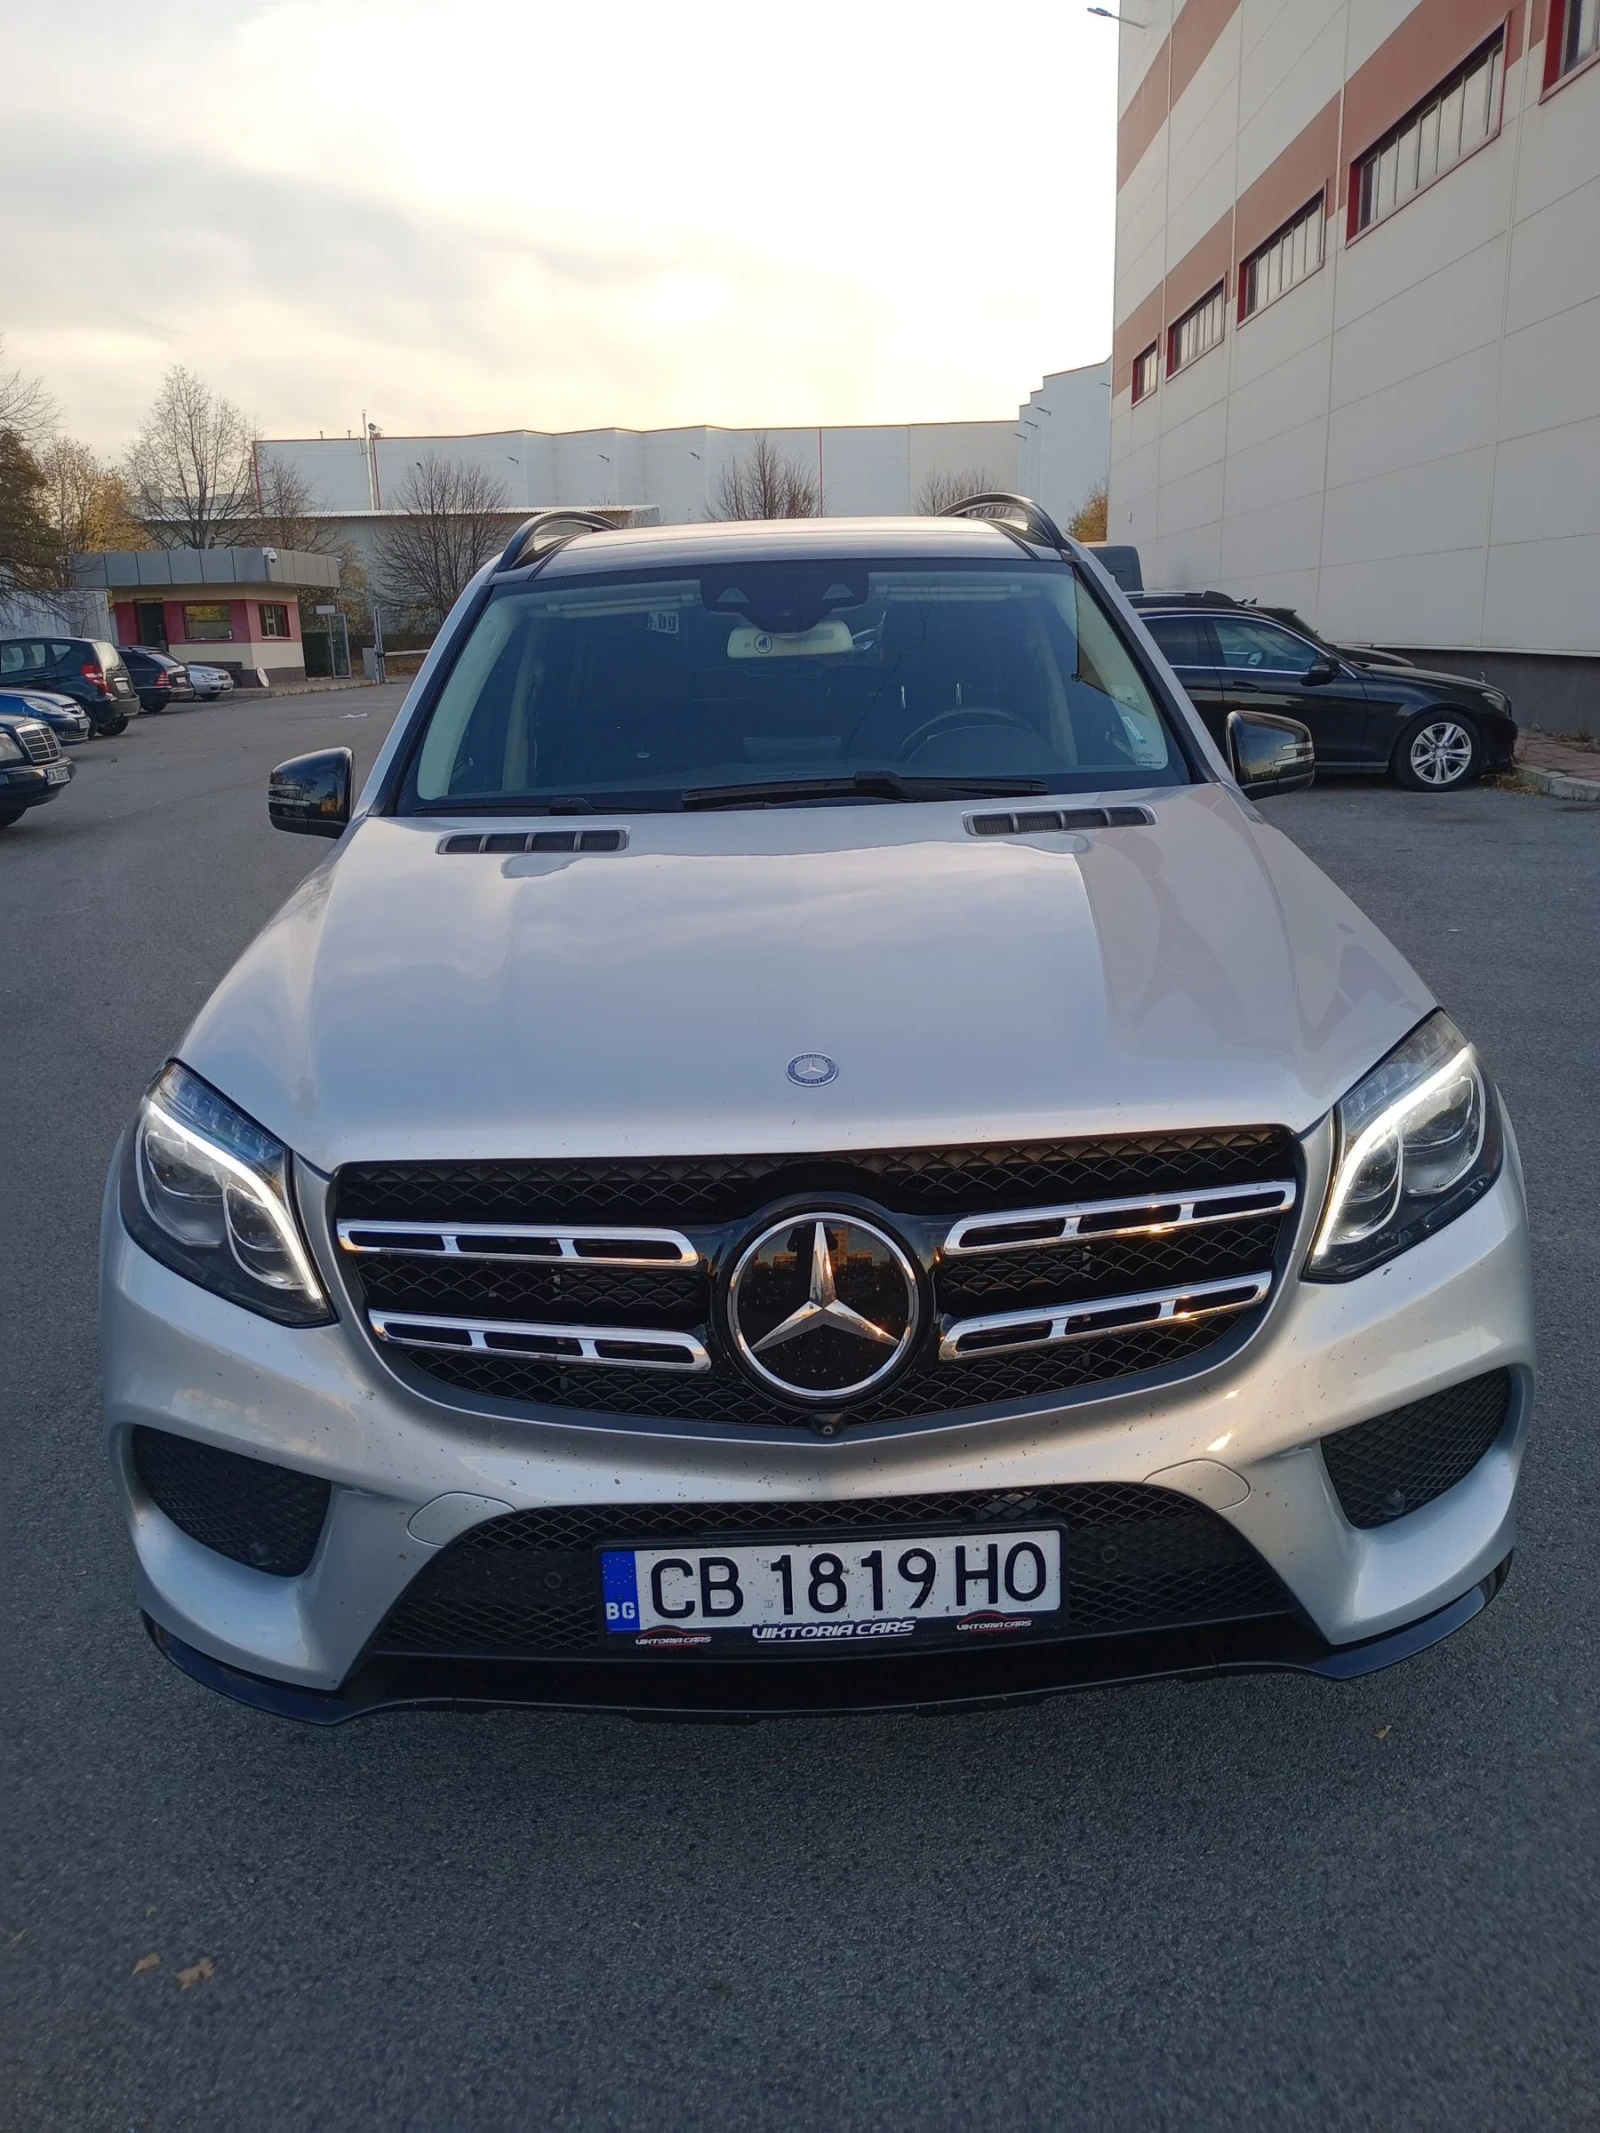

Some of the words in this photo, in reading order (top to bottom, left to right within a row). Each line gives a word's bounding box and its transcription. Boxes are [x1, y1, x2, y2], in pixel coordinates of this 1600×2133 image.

[651, 1557, 744, 1619] CB
[770, 1548, 937, 1616] 1819
[955, 1541, 1047, 1607] HO
[606, 1601, 635, 1620] BG
[752, 1624, 853, 1639] VIKTORIA
[856, 1620, 917, 1635] CARS
[1004, 1620, 1033, 1628] CARS
